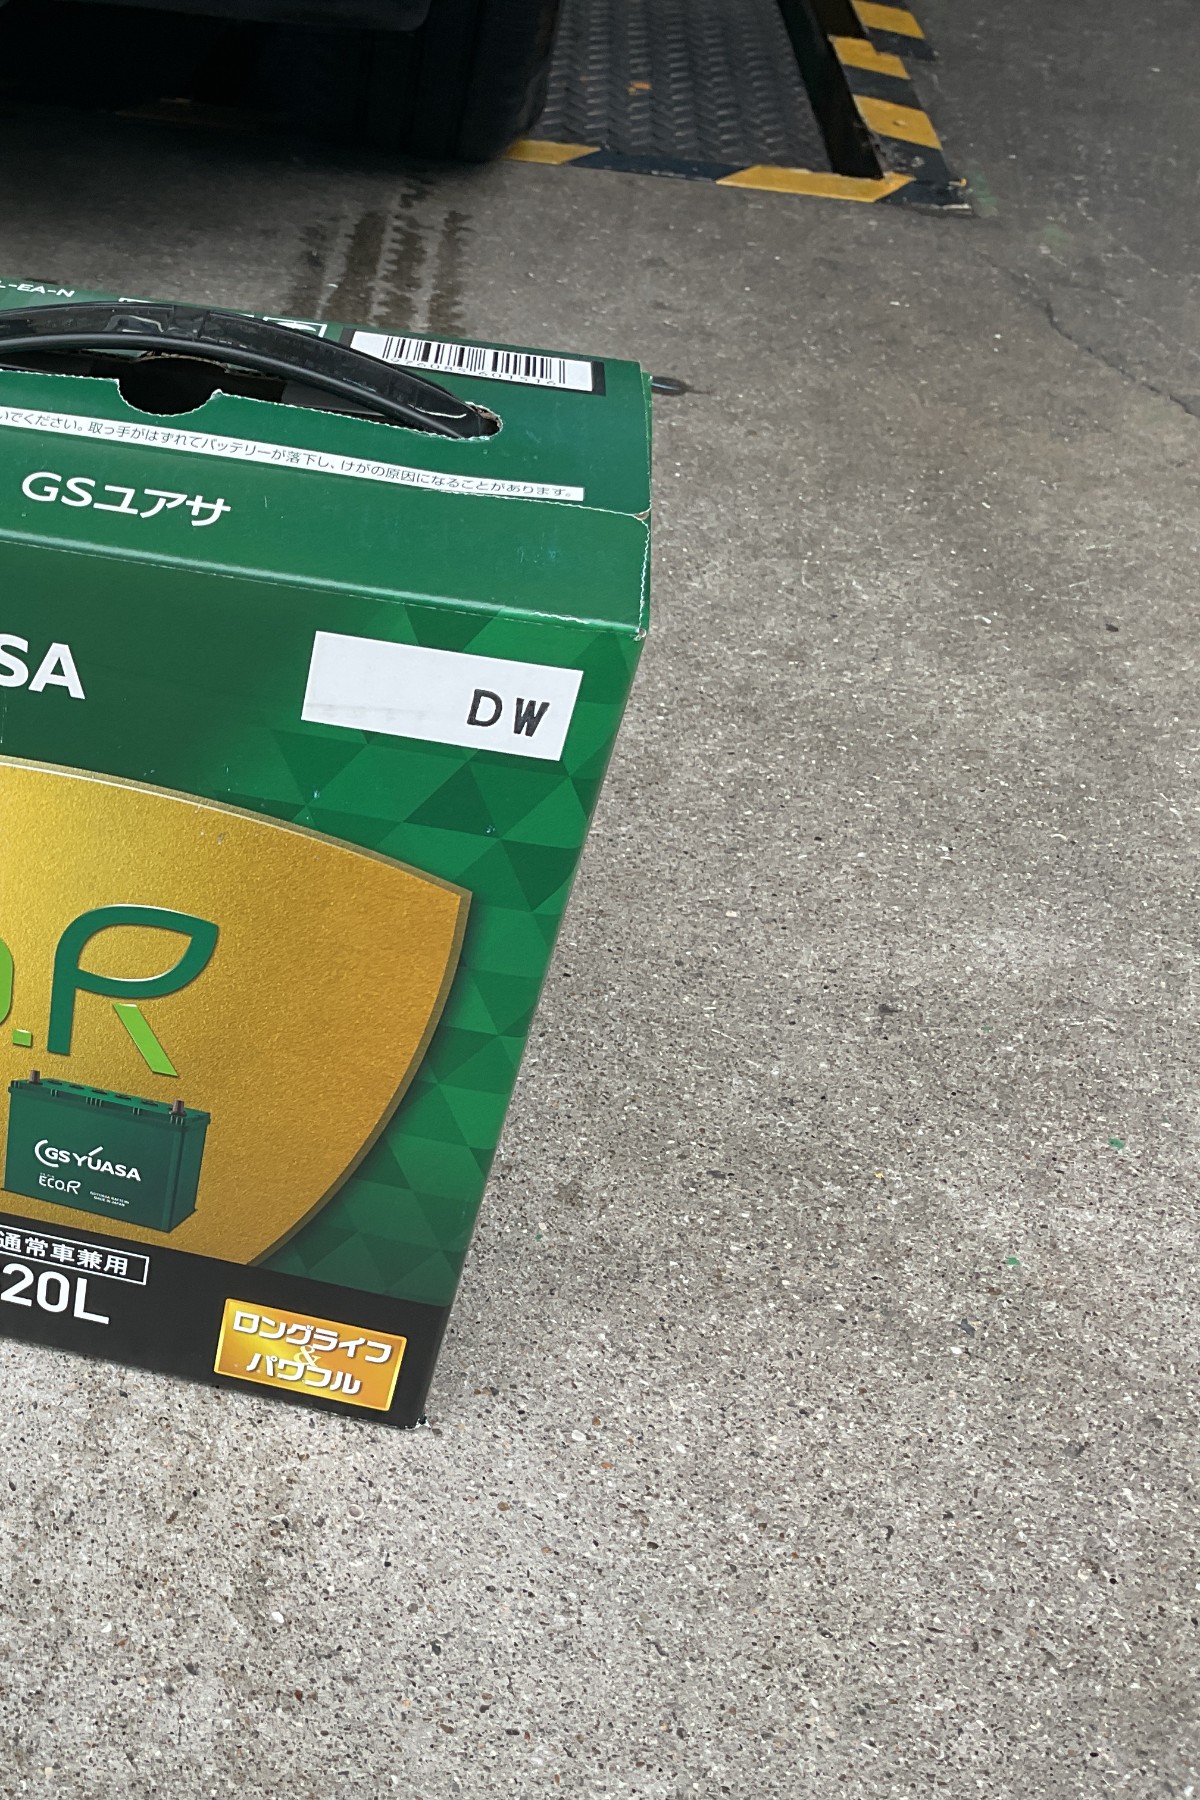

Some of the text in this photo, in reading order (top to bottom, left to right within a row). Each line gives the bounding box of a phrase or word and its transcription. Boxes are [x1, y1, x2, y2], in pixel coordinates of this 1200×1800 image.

[22, 471, 231, 527] GSユアサ
[233, 1310, 393, 1364] ロングライフ
[246, 1352, 363, 1395] パワフル
